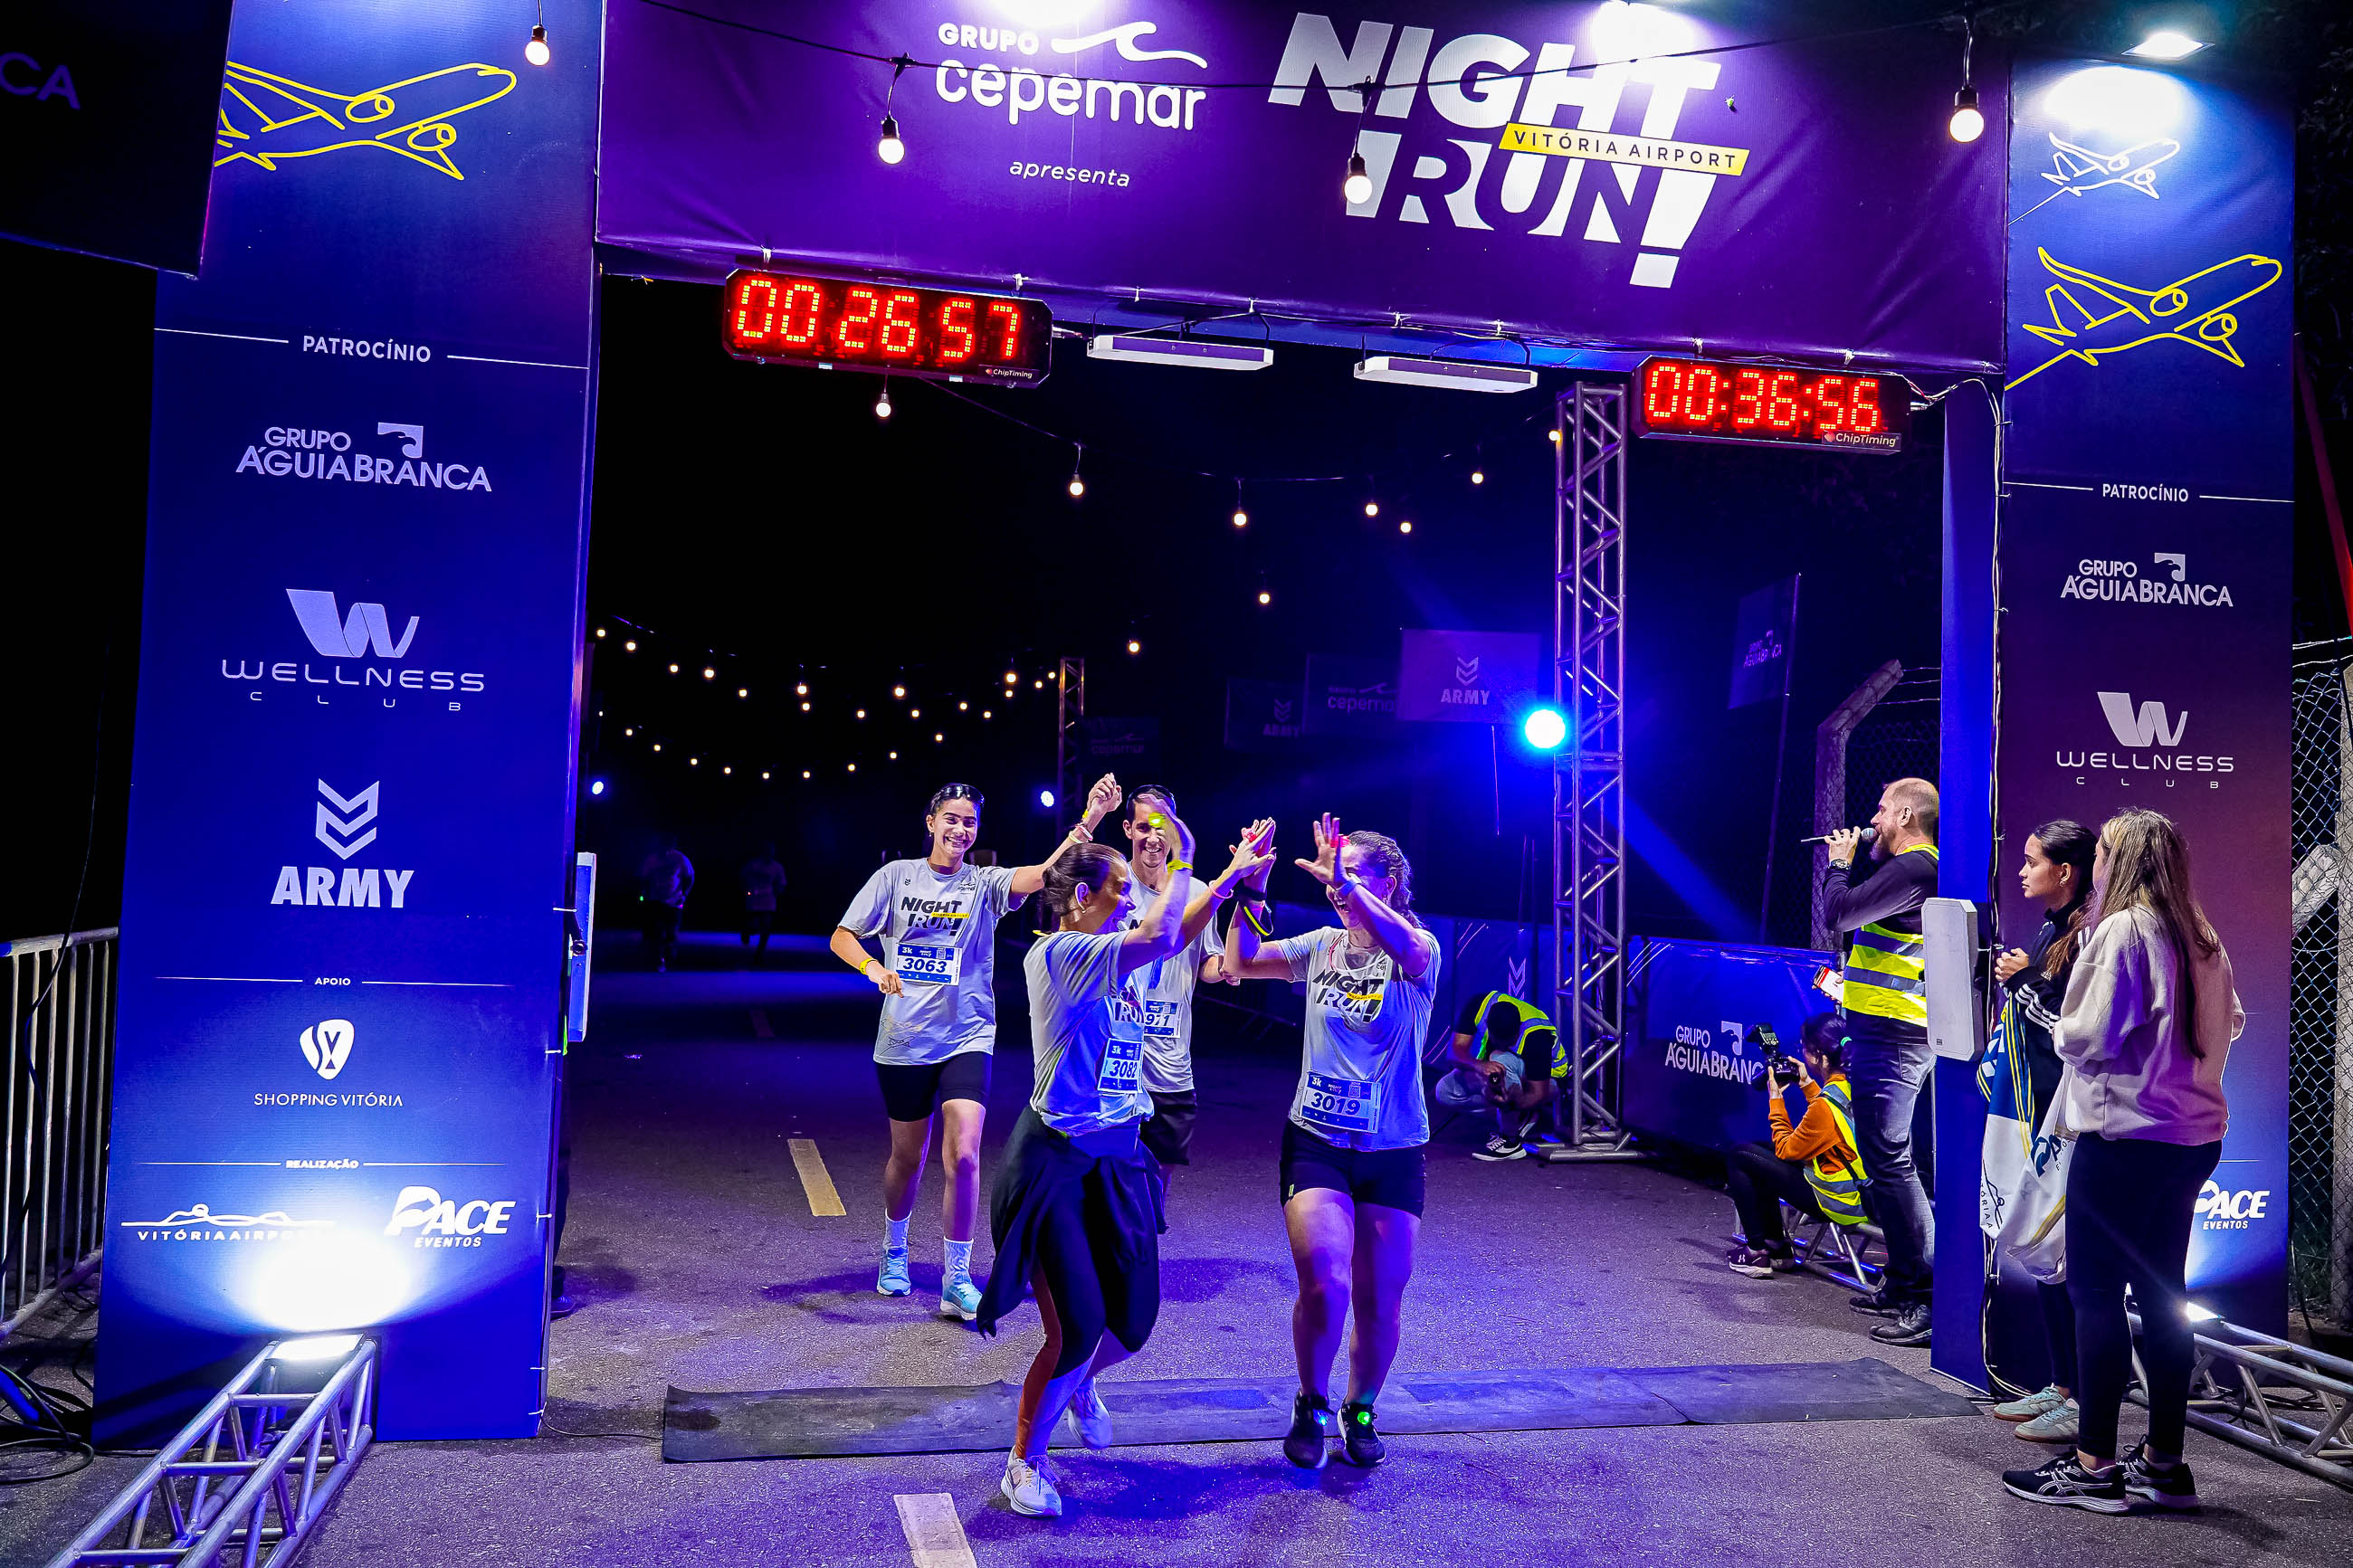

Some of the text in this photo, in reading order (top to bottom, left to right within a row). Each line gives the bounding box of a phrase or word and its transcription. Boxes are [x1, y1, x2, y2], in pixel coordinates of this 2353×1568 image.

[938, 23, 1040, 55] GRUPO
[1268, 13, 1722, 140] NIGHT
[935, 59, 1208, 130] cepemar
[1513, 129, 1737, 169] VITÓRIA AIRPORT
[1009, 159, 1131, 188] apresenta
[1346, 130, 1718, 289] RUN!
[302, 334, 432, 364] PATROCÍNIO
[993, 368, 1034, 379] ChipTiming
[1648, 365, 1880, 432] 00:36:56
[264, 426, 351, 452] GRUPO
[2101, 483, 2189, 503] PATROCÍNIO
[2079, 558, 2138, 578] GRUPO
[221, 659, 485, 693] WELLNESS
[1440, 689, 1491, 706] ARMY
[2056, 751, 2234, 773] WELLNESS
[270, 866, 414, 908] ARMY
[900, 896, 963, 914] NIGHT
[901, 946, 913, 955] 3k
[902, 957, 948, 974] 3063
[314, 977, 351, 986] APOIO
[1312, 969, 1385, 996] NIGHT
[1144, 1013, 1170, 1027] 971
[1675, 1024, 1710, 1049] GRUPO
[1110, 1045, 1122, 1055] 3k
[1109, 1060, 1138, 1079] 3082
[1664, 1041, 1764, 1085] ÁGUIABRAN
[1311, 1076, 1322, 1088] 3k
[253, 1090, 404, 1107] SHOPPING VITÓRIA
[1310, 1091, 1361, 1116] 3019
[285, 1158, 359, 1171] REALIZAÇÃO
[384, 1185, 517, 1236] PACE
[2202, 1220, 2249, 1231] EVENTOS
[414, 1236, 482, 1248] EVENTOS
